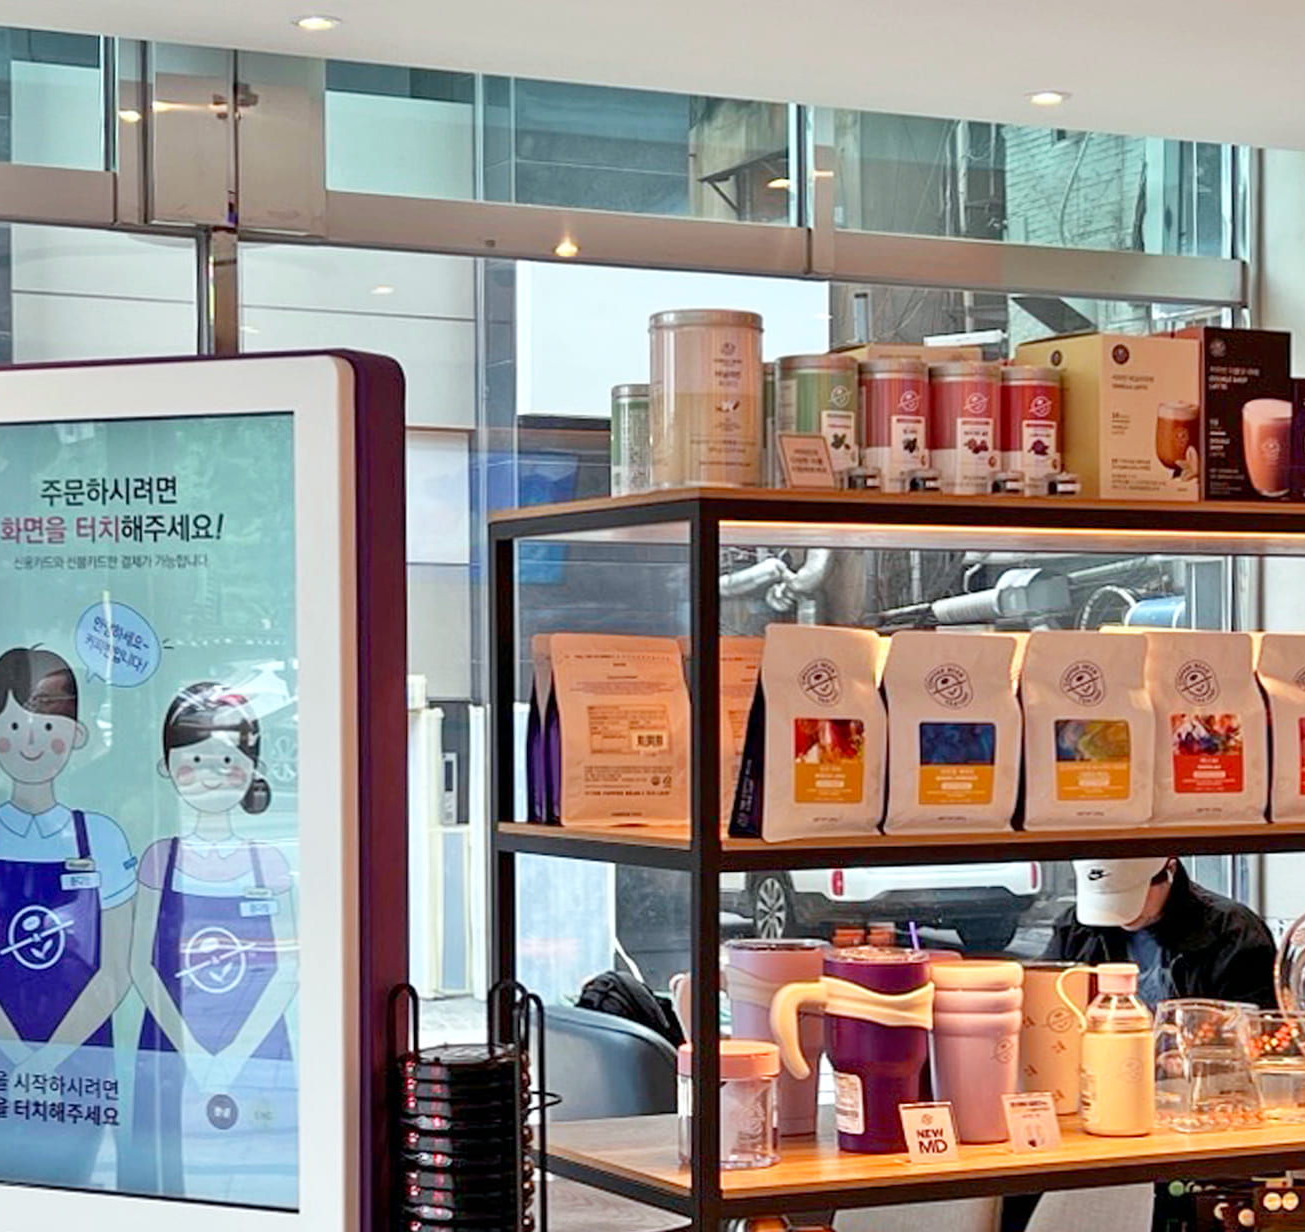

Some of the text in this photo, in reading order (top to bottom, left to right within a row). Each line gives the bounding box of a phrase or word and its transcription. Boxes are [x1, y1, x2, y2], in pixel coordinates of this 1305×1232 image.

[40, 475, 179, 508] 주문하시려면
[0, 512, 225, 545] 화면을 터치해주세요!
[13, 1072, 119, 1101] 시작하시려면
[13, 1098, 121, 1127] 터치해주세요
[916, 1128, 944, 1139] NEW
[918, 1138, 948, 1154] MD
